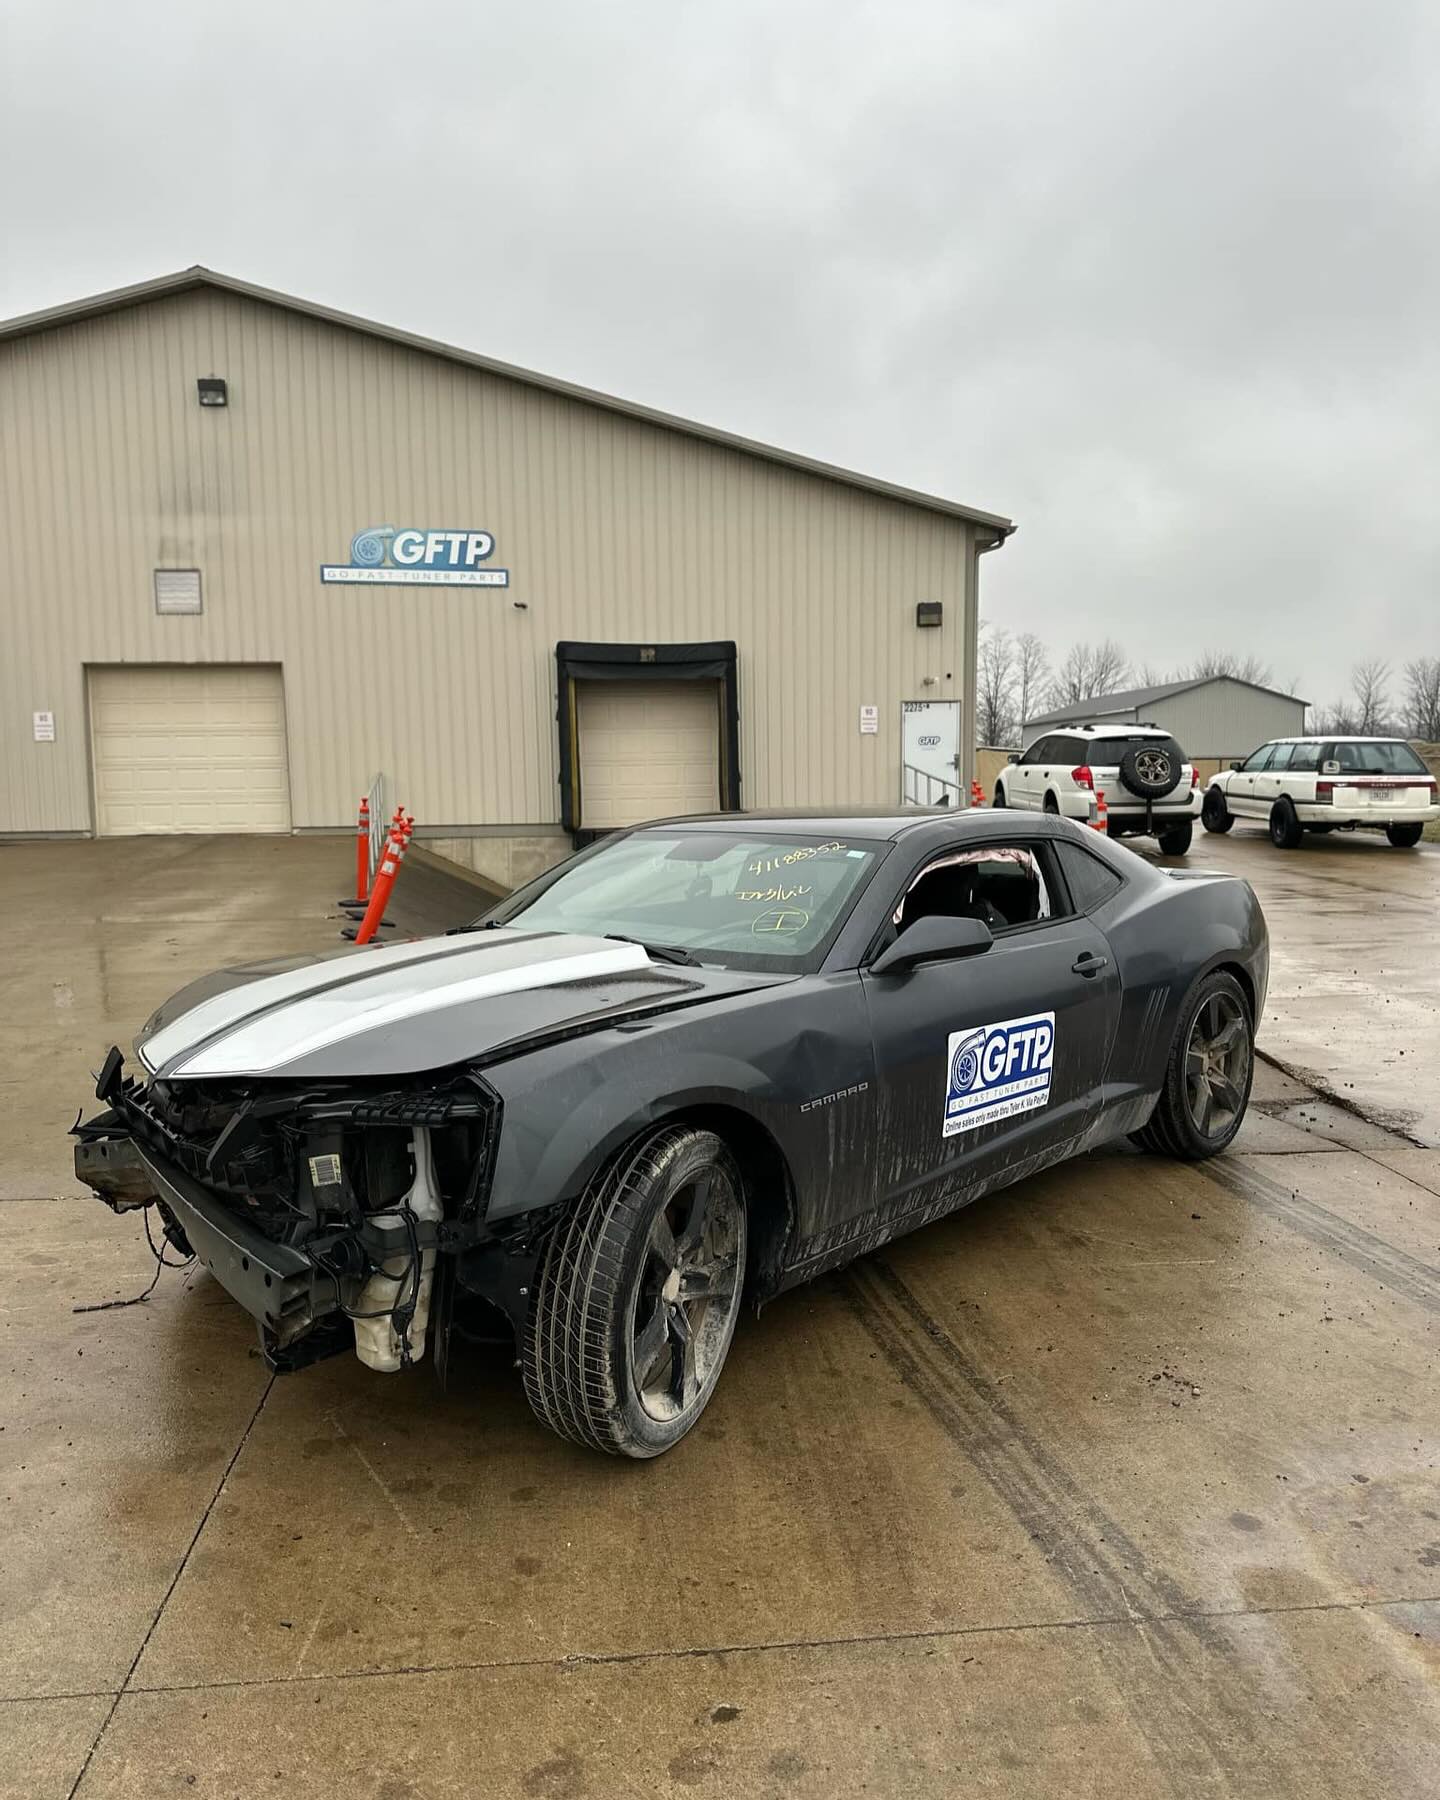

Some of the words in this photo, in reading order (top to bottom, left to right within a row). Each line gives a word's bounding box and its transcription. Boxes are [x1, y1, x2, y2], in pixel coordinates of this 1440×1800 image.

[392, 530, 492, 565] GFTP
[404, 572, 450, 581] TUNER
[460, 573, 504, 583] PARTS
[749, 842, 847, 876] 41188352
[983, 1026, 1051, 1082] GFTP
[800, 1082, 869, 1113] CAMARO
[951, 1100, 965, 1110] GO
[969, 1091, 990, 1105] FAST
[994, 1082, 1020, 1097] TUNER
[1024, 1075, 1048, 1089] PARTS
[945, 1120, 962, 1133] Online
[962, 1115, 975, 1128] sales
[975, 1111, 986, 1124] only
[986, 1107, 999, 1120] made
